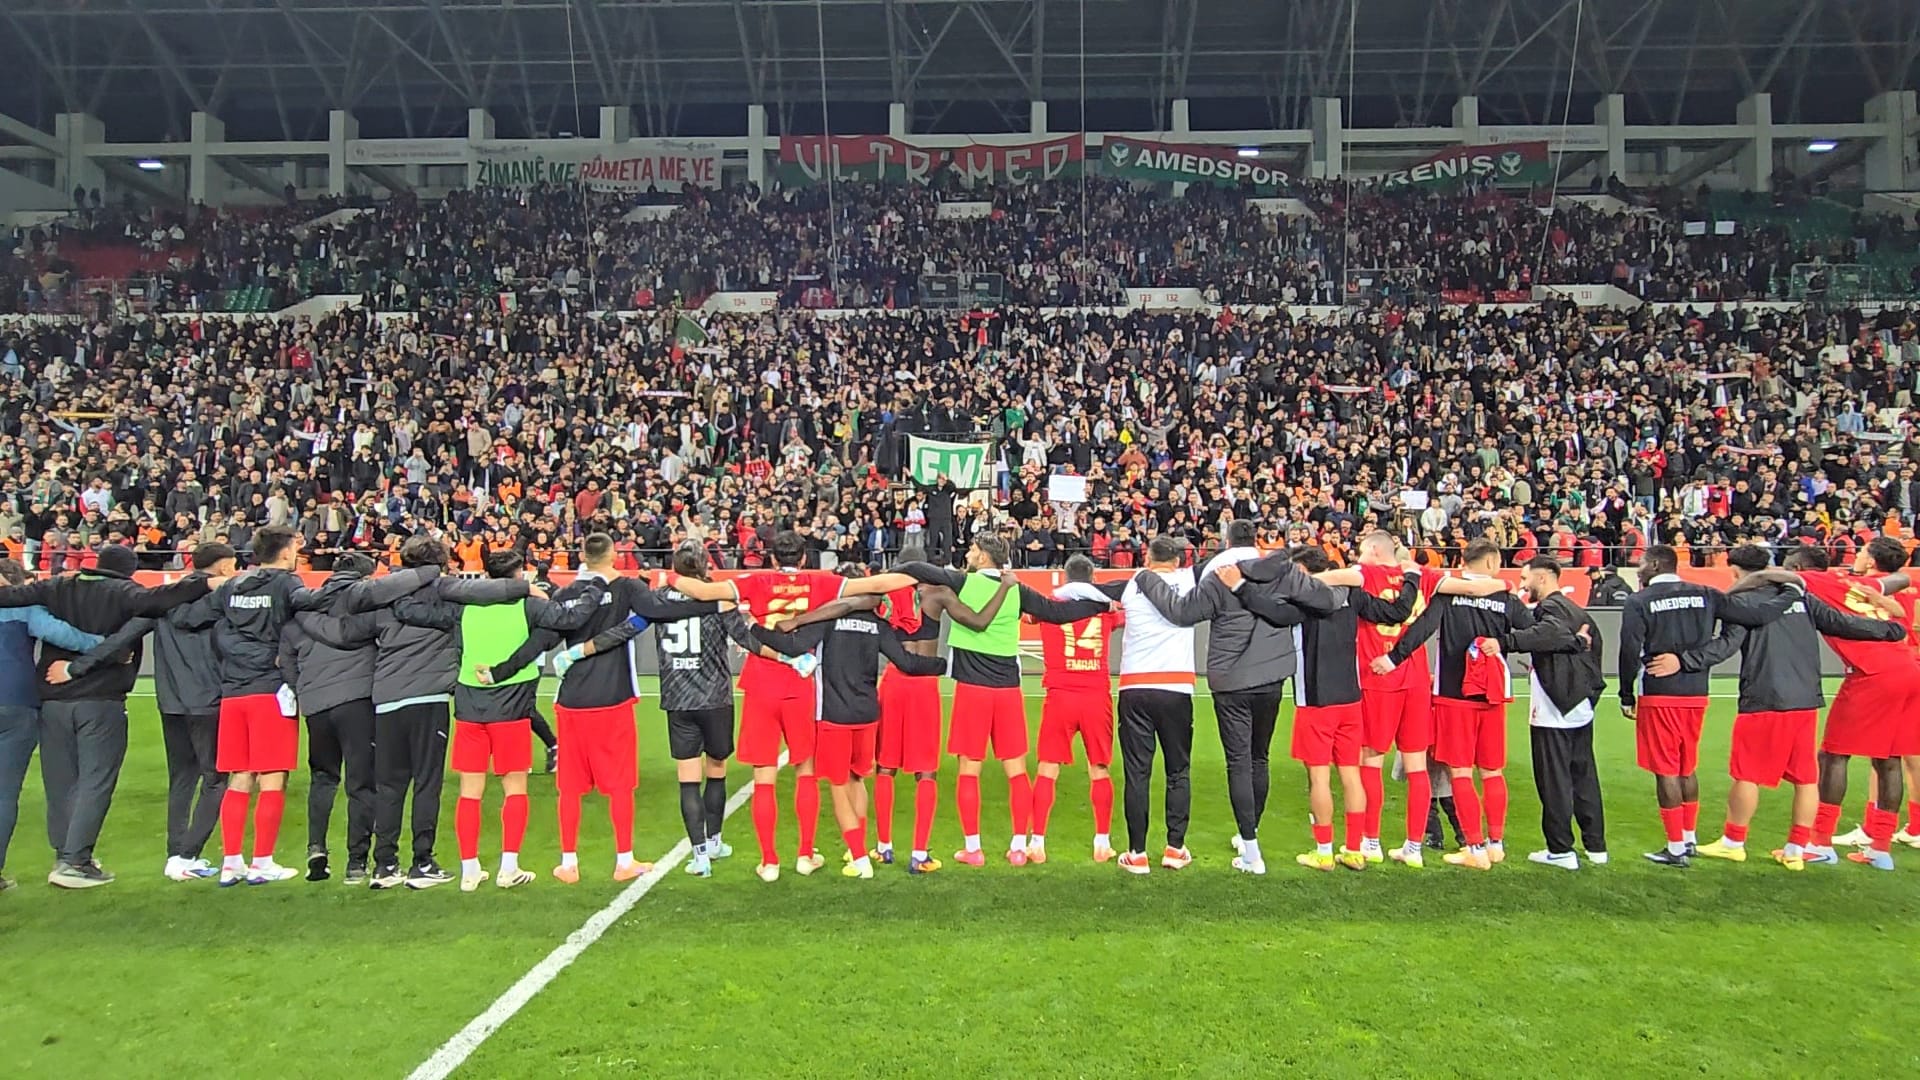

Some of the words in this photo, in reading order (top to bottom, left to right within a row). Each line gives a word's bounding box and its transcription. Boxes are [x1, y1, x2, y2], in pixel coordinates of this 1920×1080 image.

[549, 162, 576, 184] ME
[660, 156, 688, 181] ME
[691, 156, 715, 181] YE
[1135, 148, 1289, 186] AMEDSPOR
[1650, 596, 1705, 613] AMEDSPOR
[662, 617, 702, 654] 31
[1060, 616, 1103, 658] 14
